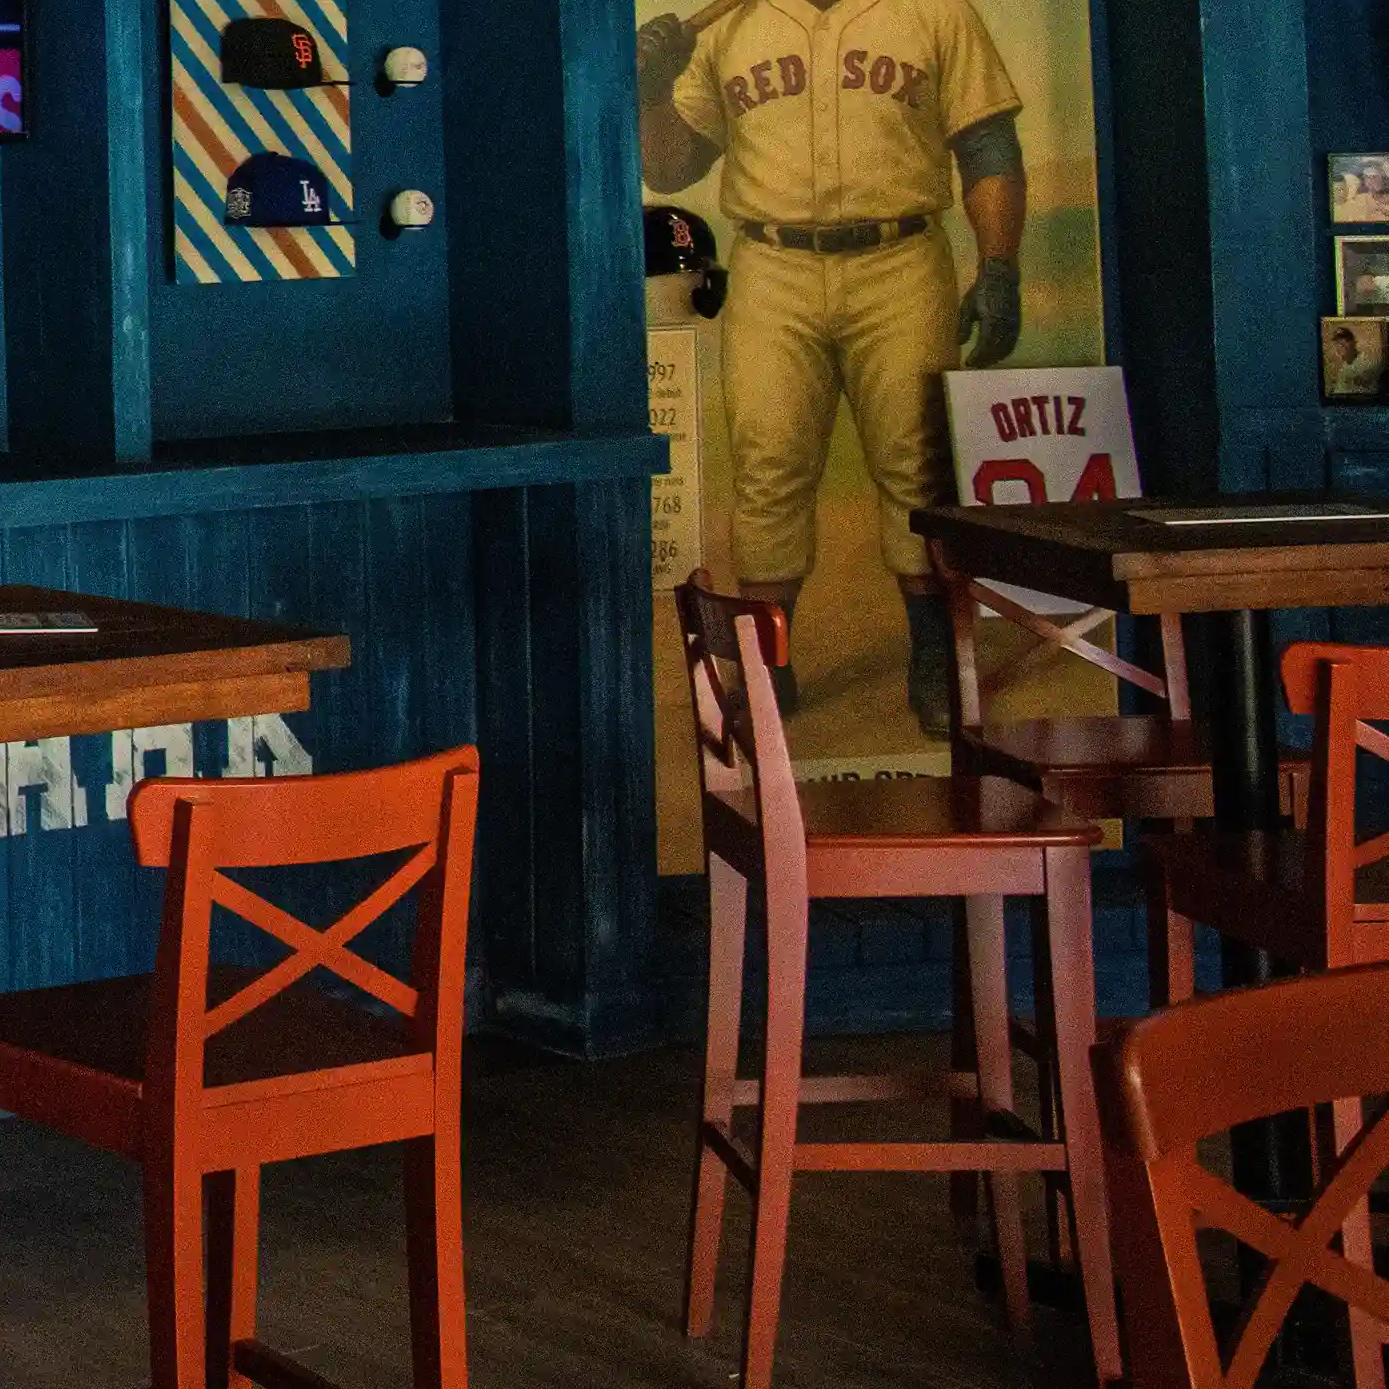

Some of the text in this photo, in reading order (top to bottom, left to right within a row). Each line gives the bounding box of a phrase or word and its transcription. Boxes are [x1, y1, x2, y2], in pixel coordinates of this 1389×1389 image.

[723, 50, 931, 118] RED SOX
[299, 179, 322, 212] LA
[990, 395, 1086, 443] ORTIZ
